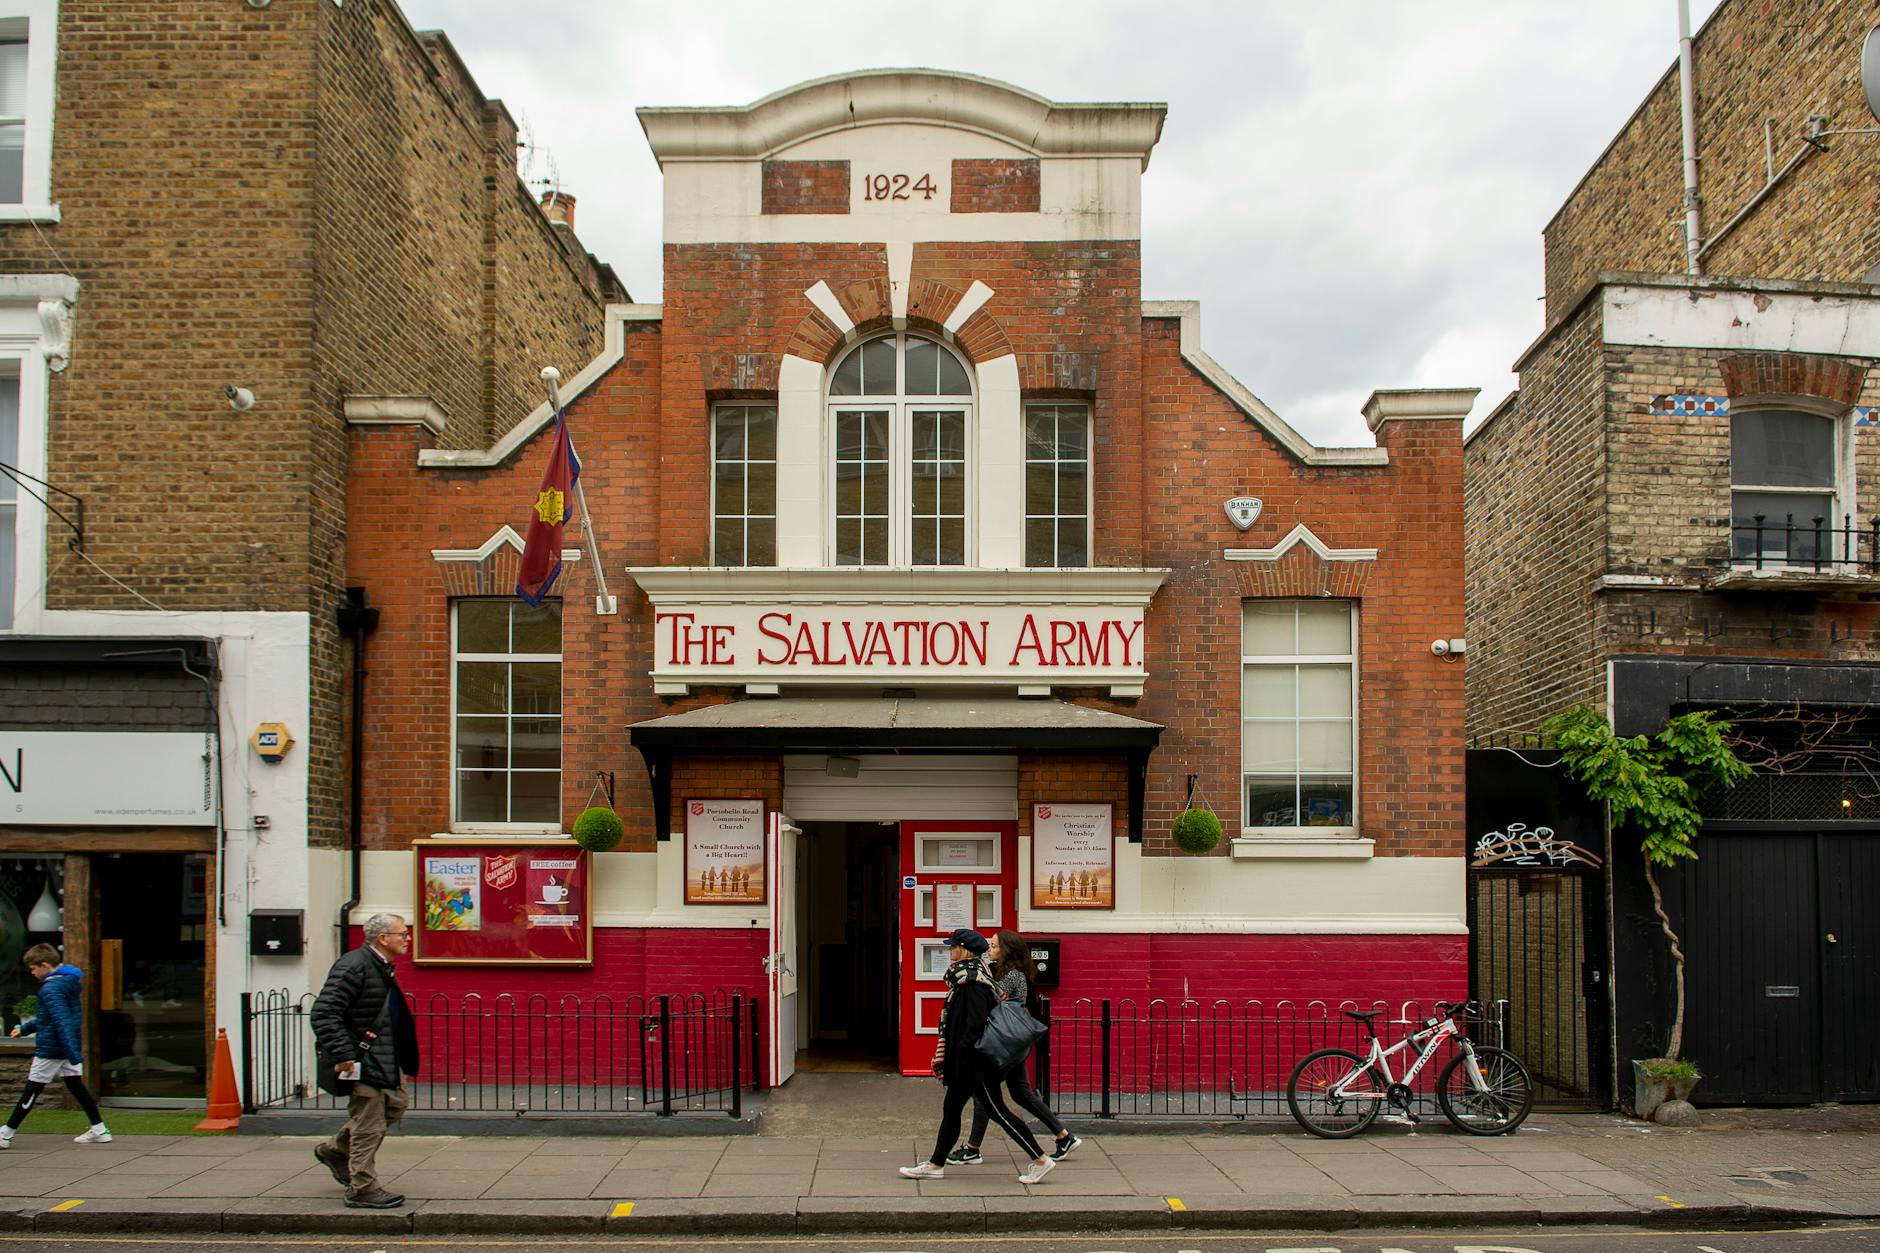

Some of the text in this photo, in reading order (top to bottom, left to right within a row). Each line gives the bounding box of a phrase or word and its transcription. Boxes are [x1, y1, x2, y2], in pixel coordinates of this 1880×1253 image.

[864, 173, 937, 201] 1924
[656, 612, 1143, 667] THE SALVATION ARMY.
[93, 807, 197, 817] www.edenperfumes.co.uk
[428, 860, 477, 875] Easter
[495, 869, 514, 887] ARMY
[1032, 951, 1048, 959] 205
